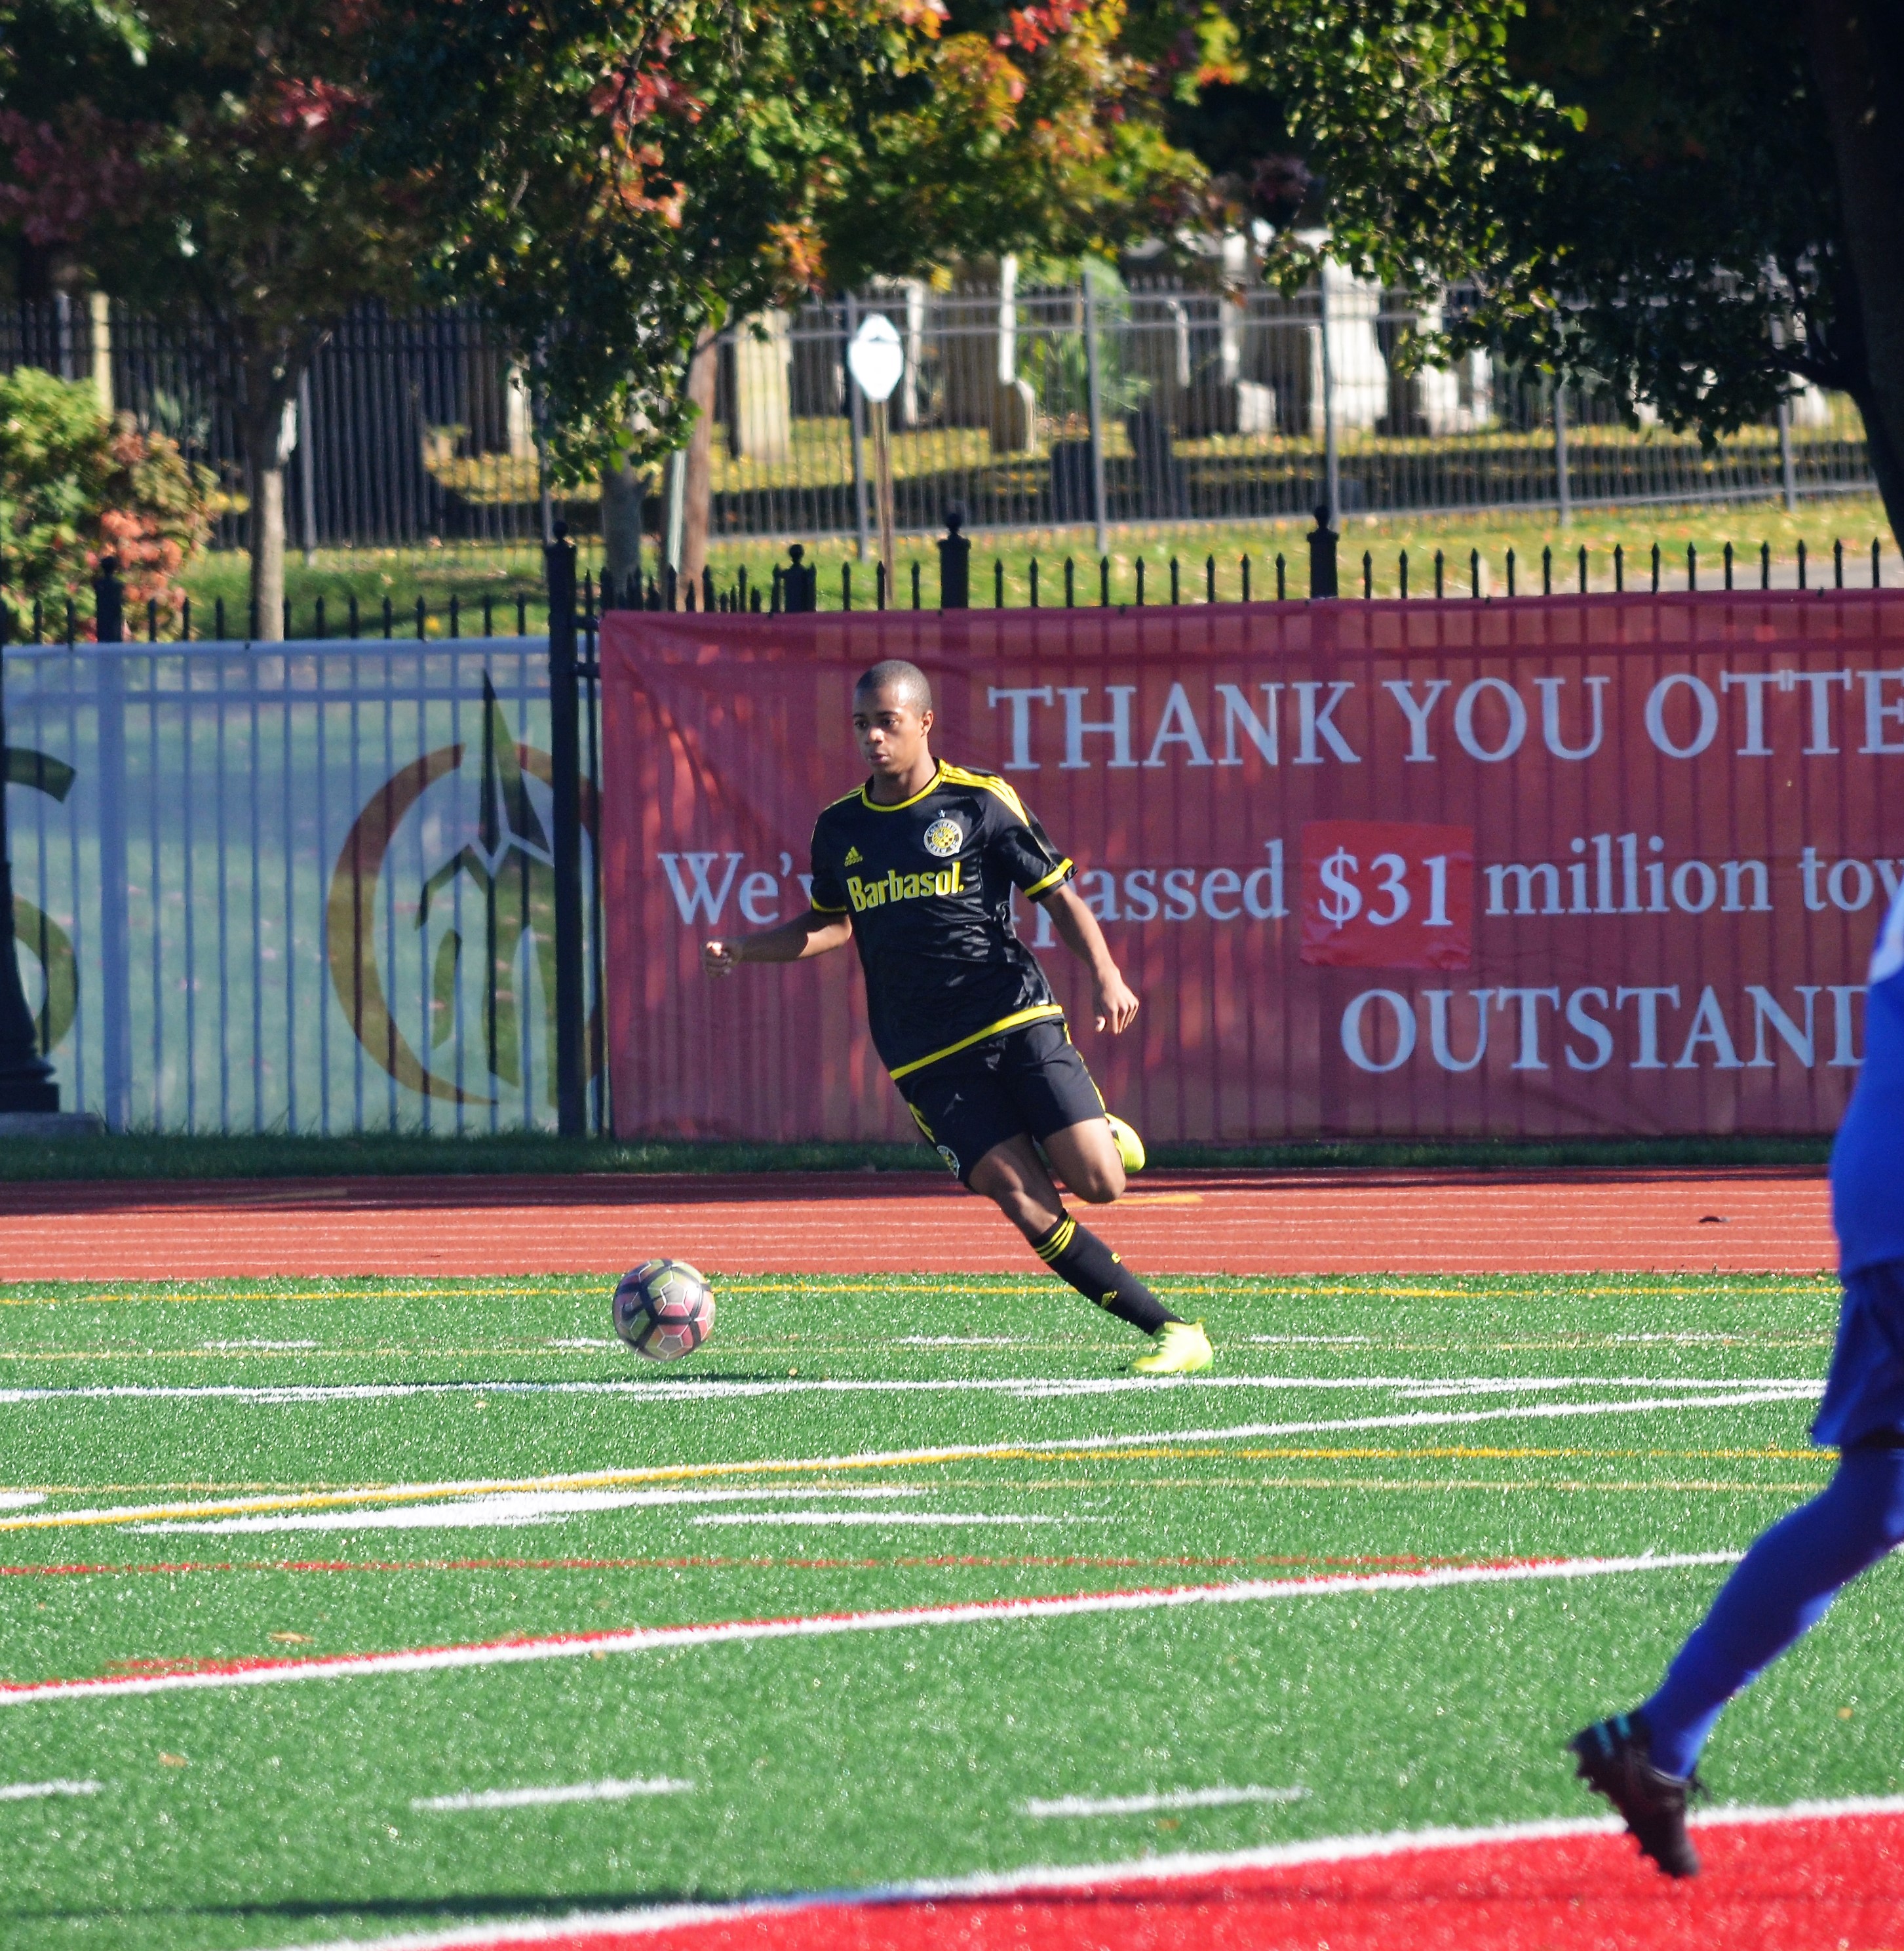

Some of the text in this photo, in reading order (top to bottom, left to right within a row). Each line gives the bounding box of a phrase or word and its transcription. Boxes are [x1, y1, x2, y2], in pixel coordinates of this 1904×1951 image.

[988, 668, 1904, 770] THANK YOU OTTE
[1317, 845, 1454, 930] $31
[1484, 833, 1774, 916] million
